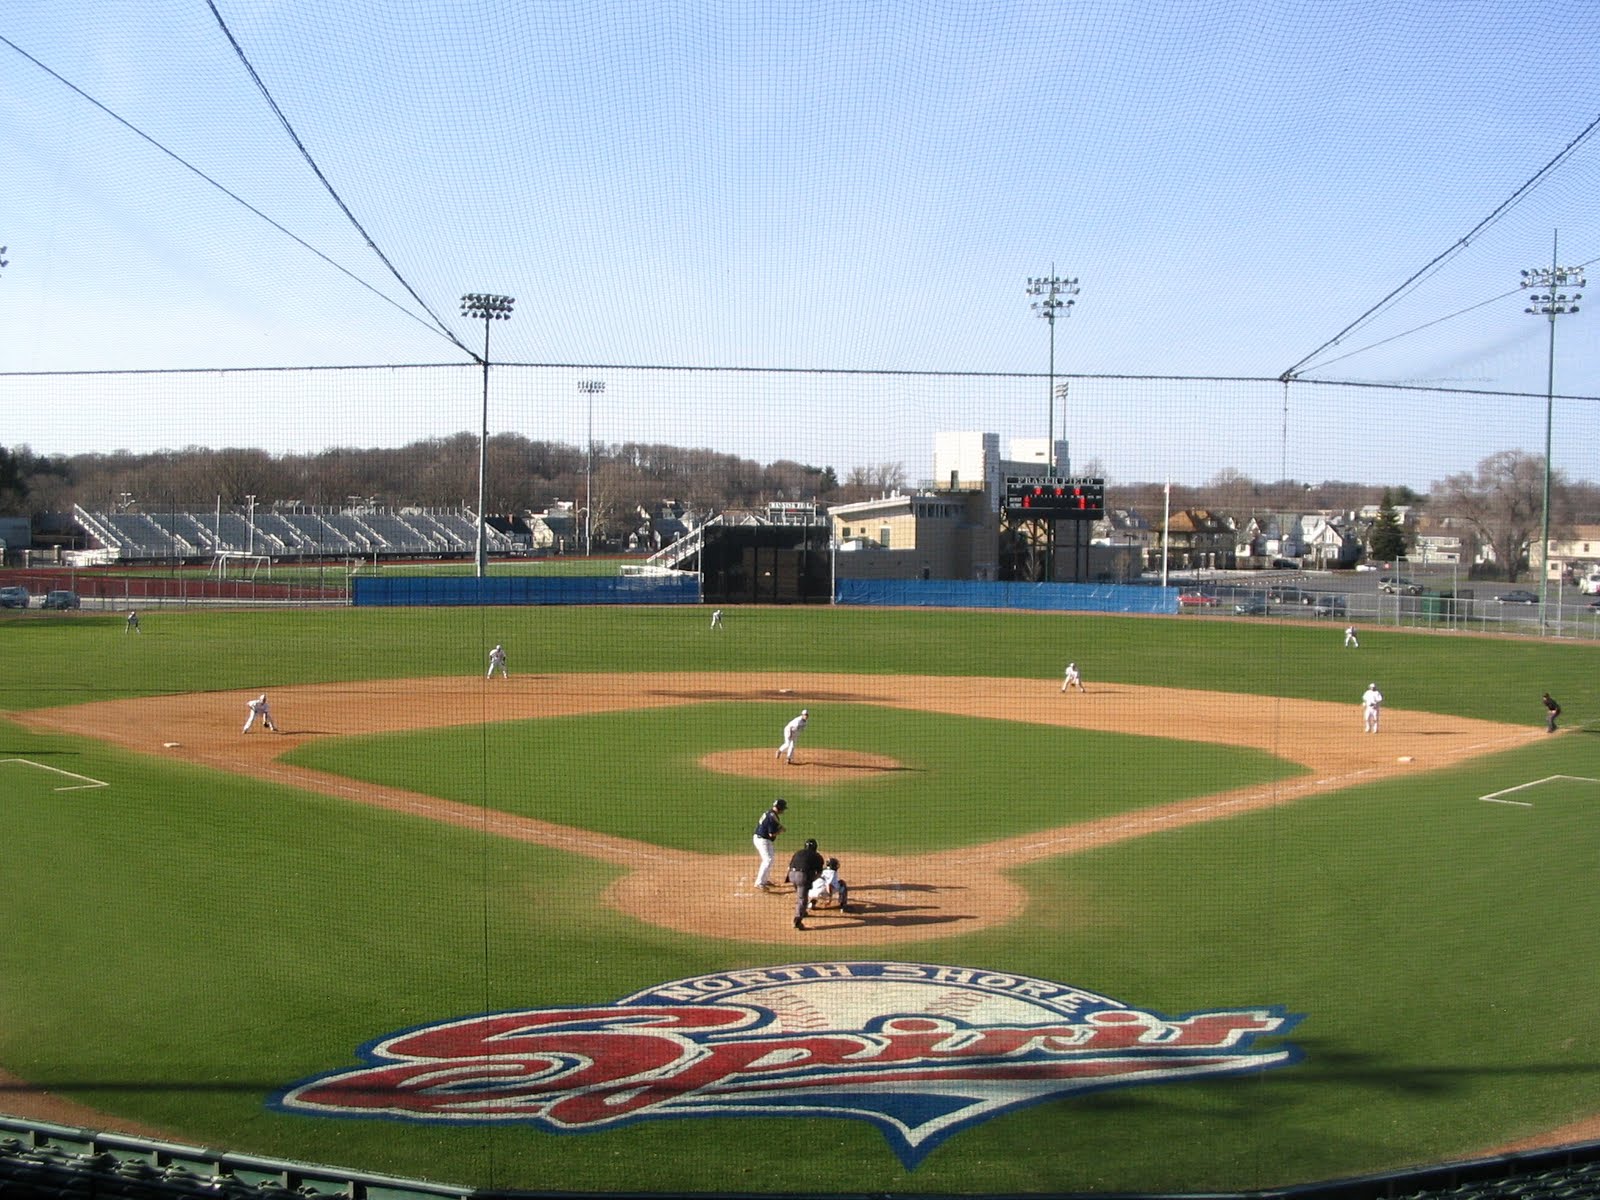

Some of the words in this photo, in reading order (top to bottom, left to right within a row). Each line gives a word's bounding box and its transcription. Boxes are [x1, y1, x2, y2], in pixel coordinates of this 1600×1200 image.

[1018, 477, 1057, 485] FRASER
[1061, 478, 1094, 486] FIELD
[652, 963, 852, 1001] NORTH
[882, 963, 1101, 1010] SHORE
[282, 1003, 1282, 1128] Spirit
